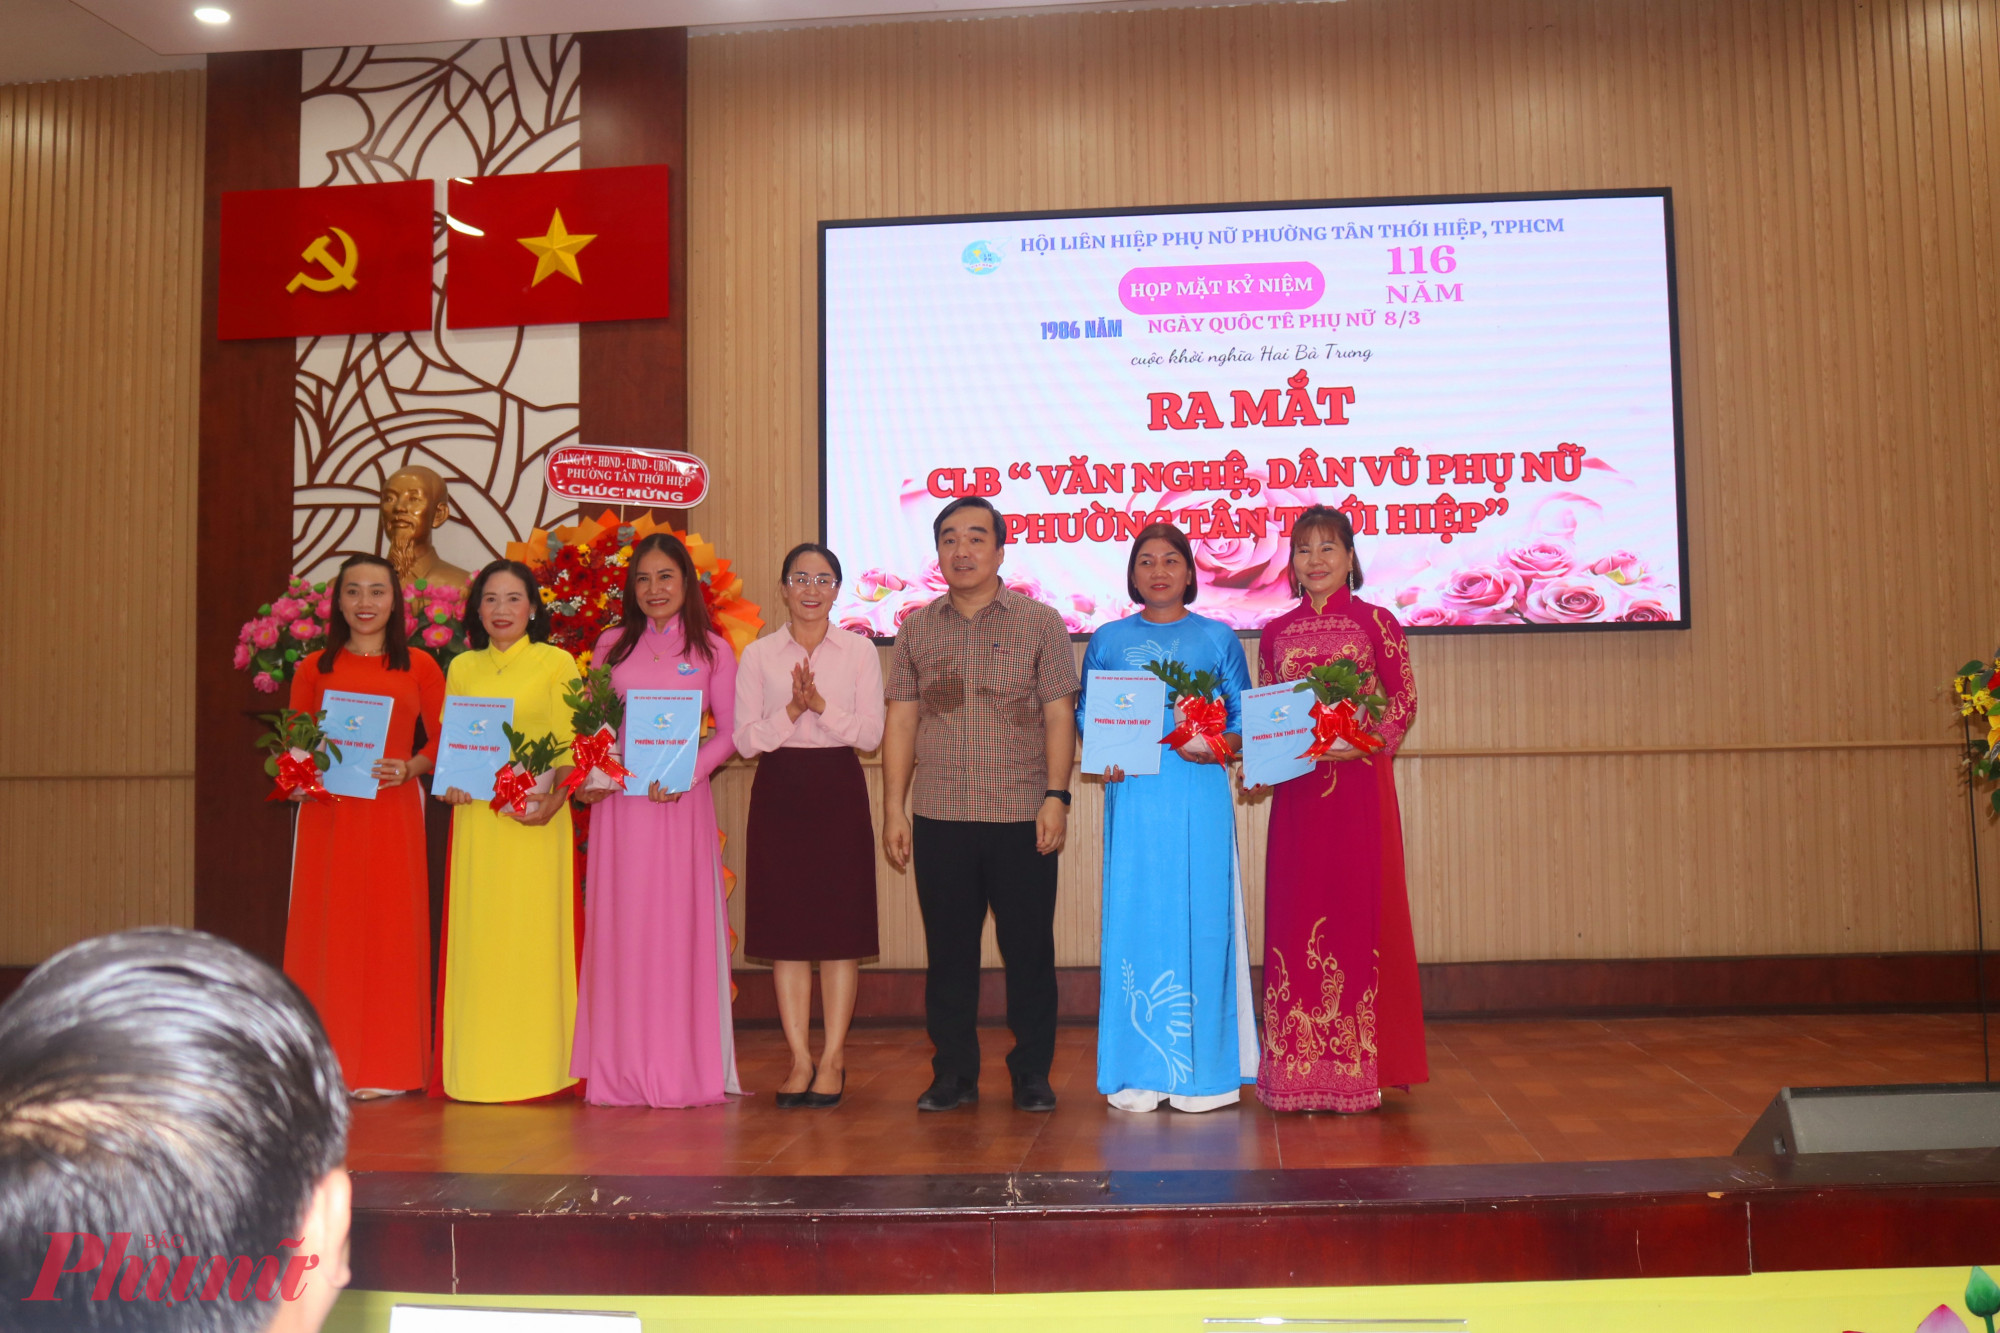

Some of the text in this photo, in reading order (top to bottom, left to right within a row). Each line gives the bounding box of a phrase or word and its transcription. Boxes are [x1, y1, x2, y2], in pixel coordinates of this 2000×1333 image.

[1021, 217, 1565, 256] HỘI LIÊN HIỆP PHỤ NỮ PHƯỜNG TÂN THỚI HIỆP, TPHCM
[1387, 244, 1457, 275] 116
[1130, 273, 1313, 302] HỌP MẶT KỶ NIỆM
[1386, 280, 1464, 304] NĂM
[1041, 316, 1122, 340] 1986 NĂM
[1148, 315, 1204, 333] NGÀY
[1299, 312, 1341, 332] PHỤ
[1346, 308, 1376, 327] NỮ
[1384, 310, 1421, 329] 8/3
[1131, 343, 1373, 368] cuộc khởi nghĩa Hai Bà Trưng
[1147, 368, 1355, 430] RA MẮT
[598, 455, 620, 468] HĐND
[626, 457, 648, 471] UBND
[927, 466, 1002, 499] CLB
[1131, 449, 1261, 500] NGHỆ,
[1266, 447, 1356, 489] DÂN
[1360, 446, 1420, 486] VŨ
[1427, 451, 1515, 493] PHỤ
[1521, 442, 1586, 483] NỮ
[567, 467, 691, 489] PHƯỜNG TÂN THỚI HIỆP
[568, 483, 683, 501] CHÚC MỪNG
[1180, 498, 1270, 540] TÂN
[1276, 494, 1379, 538] TỚI
[1386, 492, 1509, 544] HIỆP”
